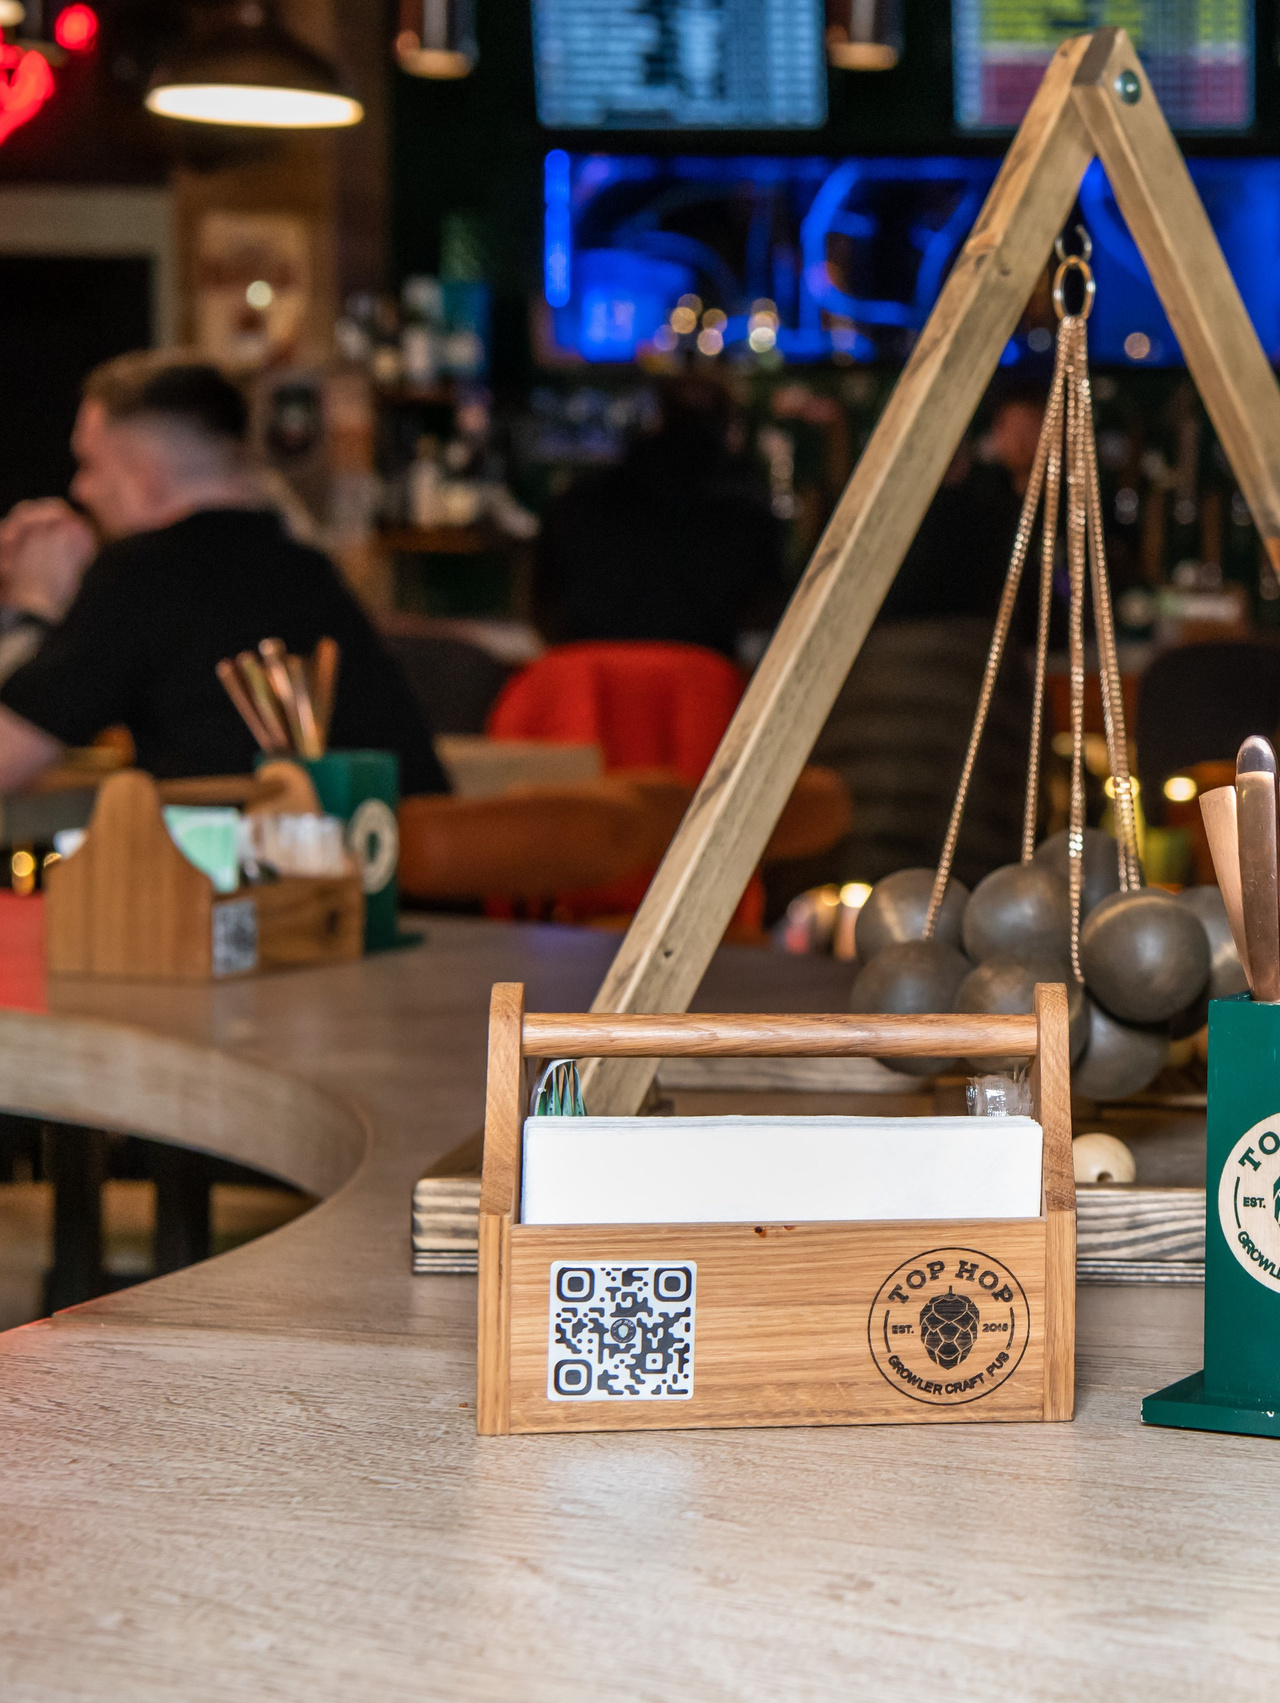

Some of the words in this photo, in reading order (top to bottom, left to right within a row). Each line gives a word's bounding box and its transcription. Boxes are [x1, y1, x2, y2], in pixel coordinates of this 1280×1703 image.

[1243, 1196, 1266, 1209] EST.
[887, 1260, 945, 1304] TOP
[955, 1260, 1014, 1303] HOP
[891, 1324, 915, 1335] EST.
[888, 1355, 943, 1395] GROWLER
[944, 1372, 985, 1395] CRAFT
[985, 1351, 1010, 1377] PUB
